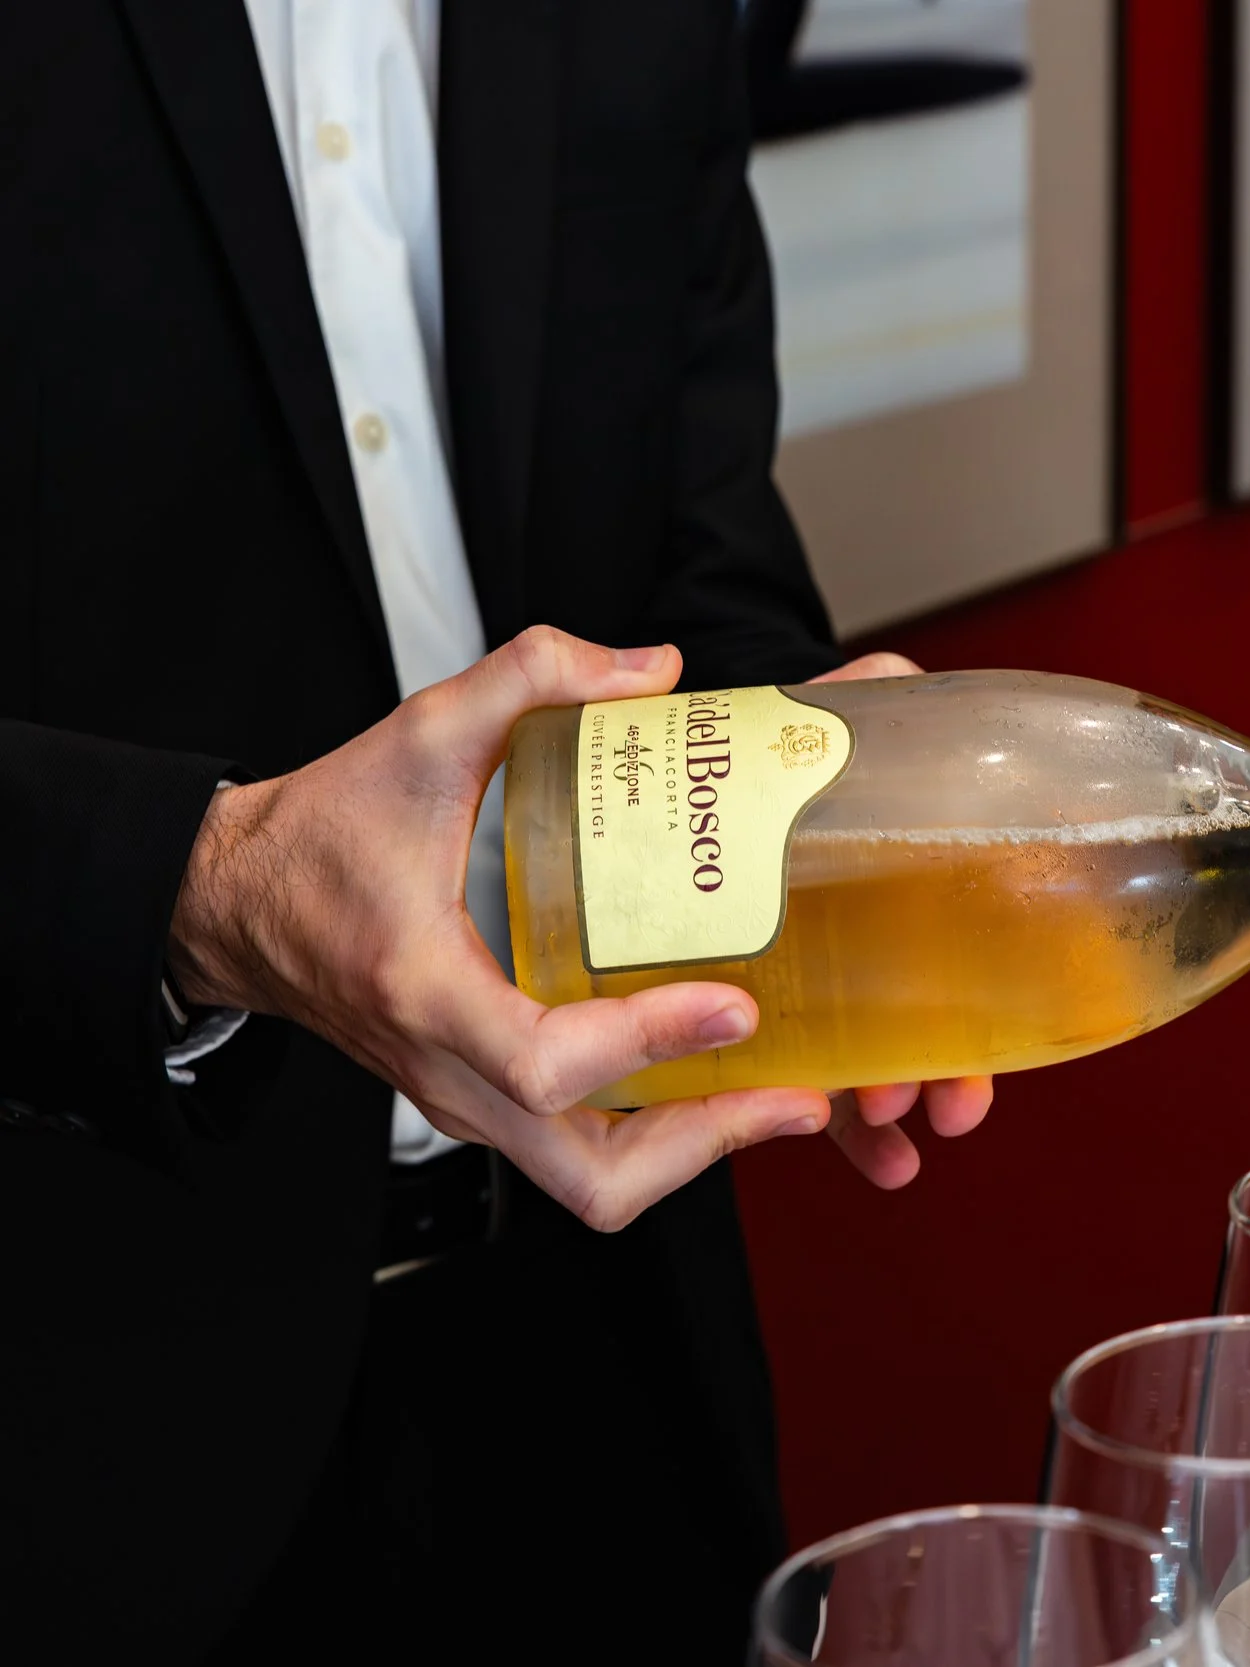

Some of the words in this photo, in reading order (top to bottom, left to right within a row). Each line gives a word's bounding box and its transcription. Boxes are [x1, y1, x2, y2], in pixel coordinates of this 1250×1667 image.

[591, 714, 605, 750] CUVÉE
[663, 707, 679, 832] FRANCIACORTA
[591, 754, 605, 839] PRESTIGE
[626, 744, 640, 807] EDIZIONE
[686, 750, 731, 893] Bosco
